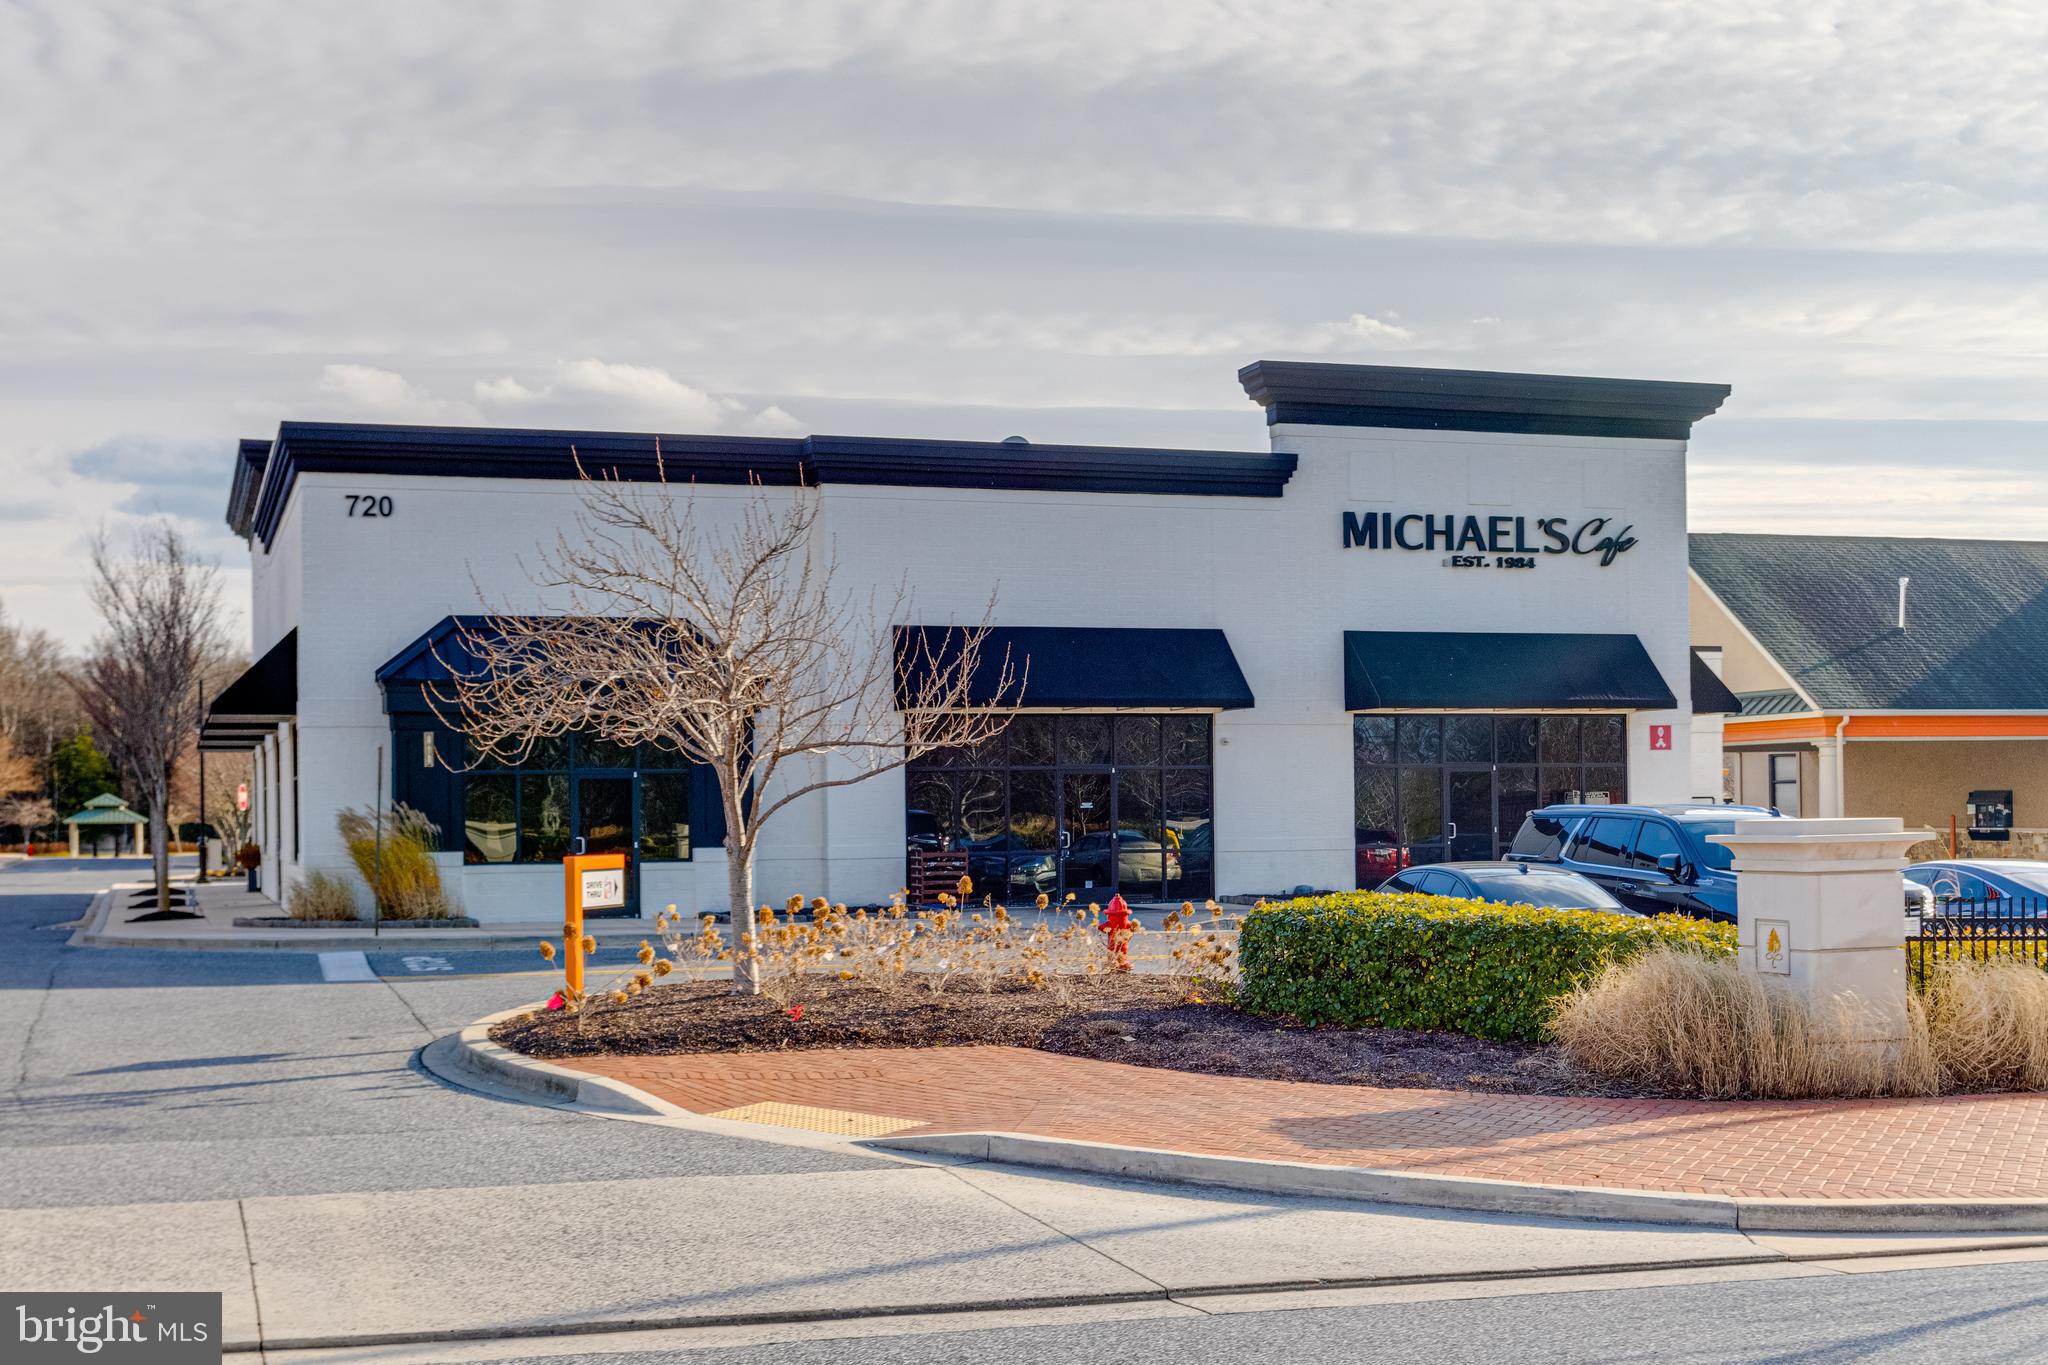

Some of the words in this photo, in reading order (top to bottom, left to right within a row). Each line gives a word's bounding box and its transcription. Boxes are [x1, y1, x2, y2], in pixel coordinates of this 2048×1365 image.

[345, 495, 393, 517] 720
[1342, 511, 1570, 554] MICHAEL'S
[1452, 555, 1490, 567] EST.
[1496, 557, 1536, 569] 1984
